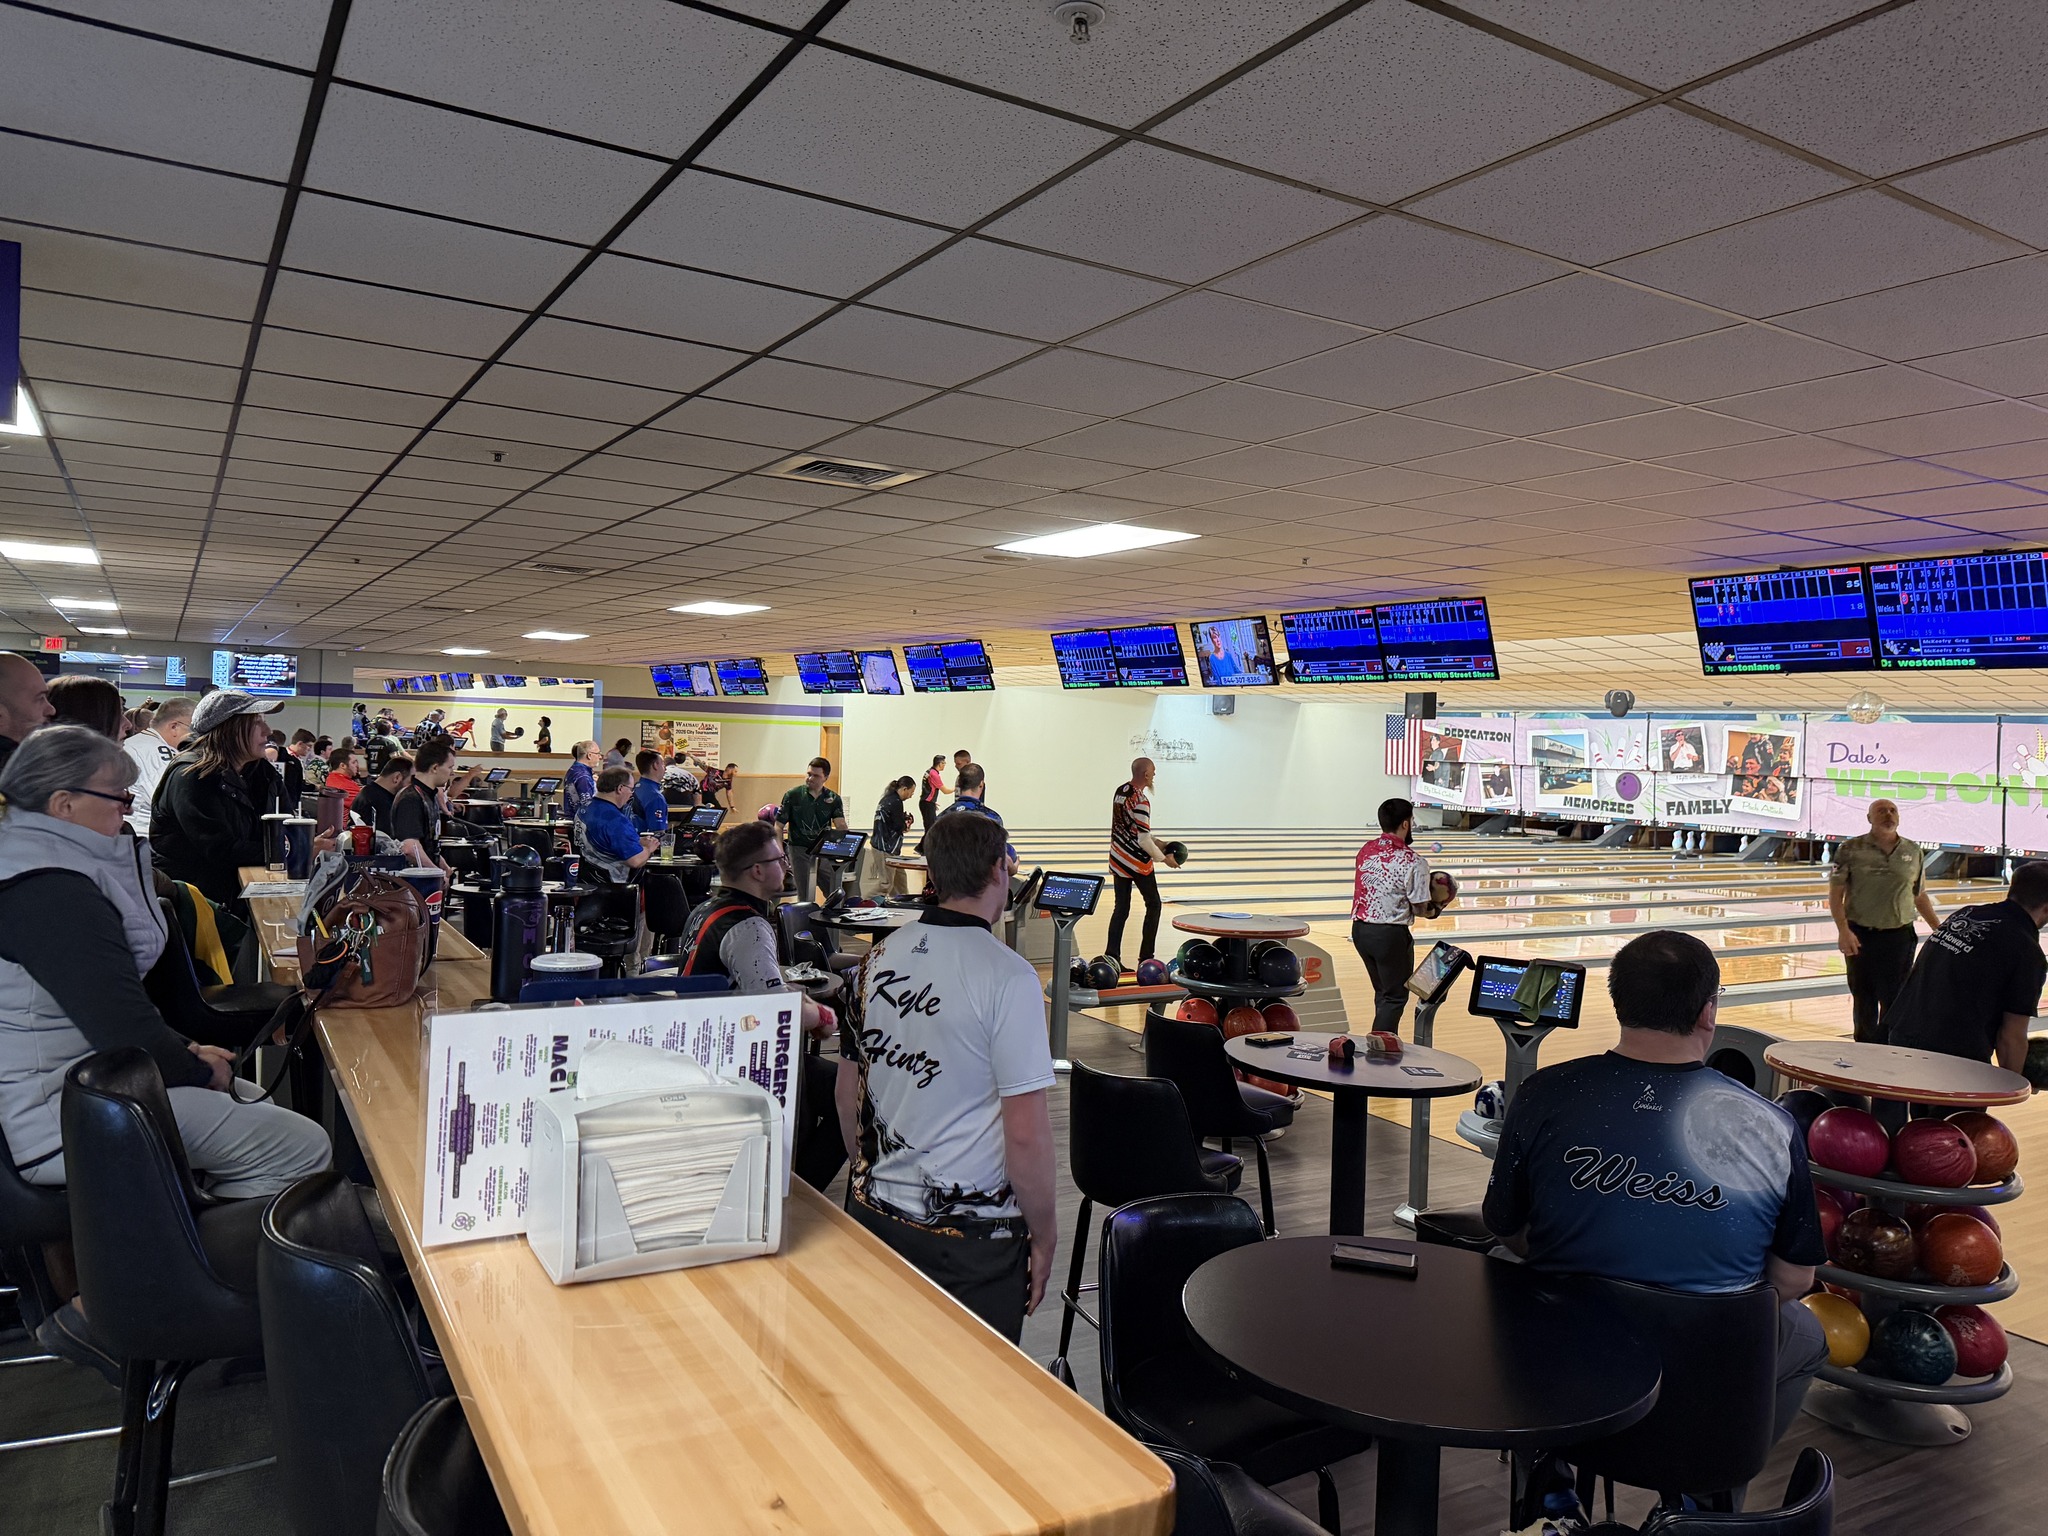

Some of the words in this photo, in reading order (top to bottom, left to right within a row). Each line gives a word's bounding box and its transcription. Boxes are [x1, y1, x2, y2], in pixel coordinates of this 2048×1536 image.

[1846, 580, 1861, 588] 35
[1874, 582, 1889, 590] Hintz
[1946, 580, 1954, 588] 65
[1850, 602, 1864, 610] 18
[45, 637, 63, 650] EXIT
[1856, 646, 1870, 654] 28
[1898, 657, 1976, 667] westonlanes
[1718, 664, 1781, 672] westonlanes
[1444, 728, 1511, 743] DEDICATION
[370, 752, 378, 760] 37
[1827, 742, 1890, 765] Dale's
[1826, 768, 2030, 807] WESTON
[1563, 796, 1634, 814] MEMORIES
[1666, 799, 1733, 816] FAMILY
[1560, 814, 1589, 822] WESTON
[1590, 815, 1612, 823] LANES
[1700, 824, 1732, 833] WESTON
[1734, 826, 1760, 835] LANES
[1795, 831, 1807, 839] 26
[1916, 842, 1940, 850] NES
[1984, 845, 1997, 854] 28
[2009, 848, 2024, 857] 29
[428, 904, 441, 912] PEP
[1940, 939, 1962, 955] Company
[1942, 931, 1974, 953] Howard
[870, 970, 940, 1019] Kyle
[552, 1035, 569, 1081] MAC
[772, 1010, 792, 1109] BURGERS
[860, 1028, 942, 1089] Hintz
[1564, 1146, 1729, 1211] Weiss
